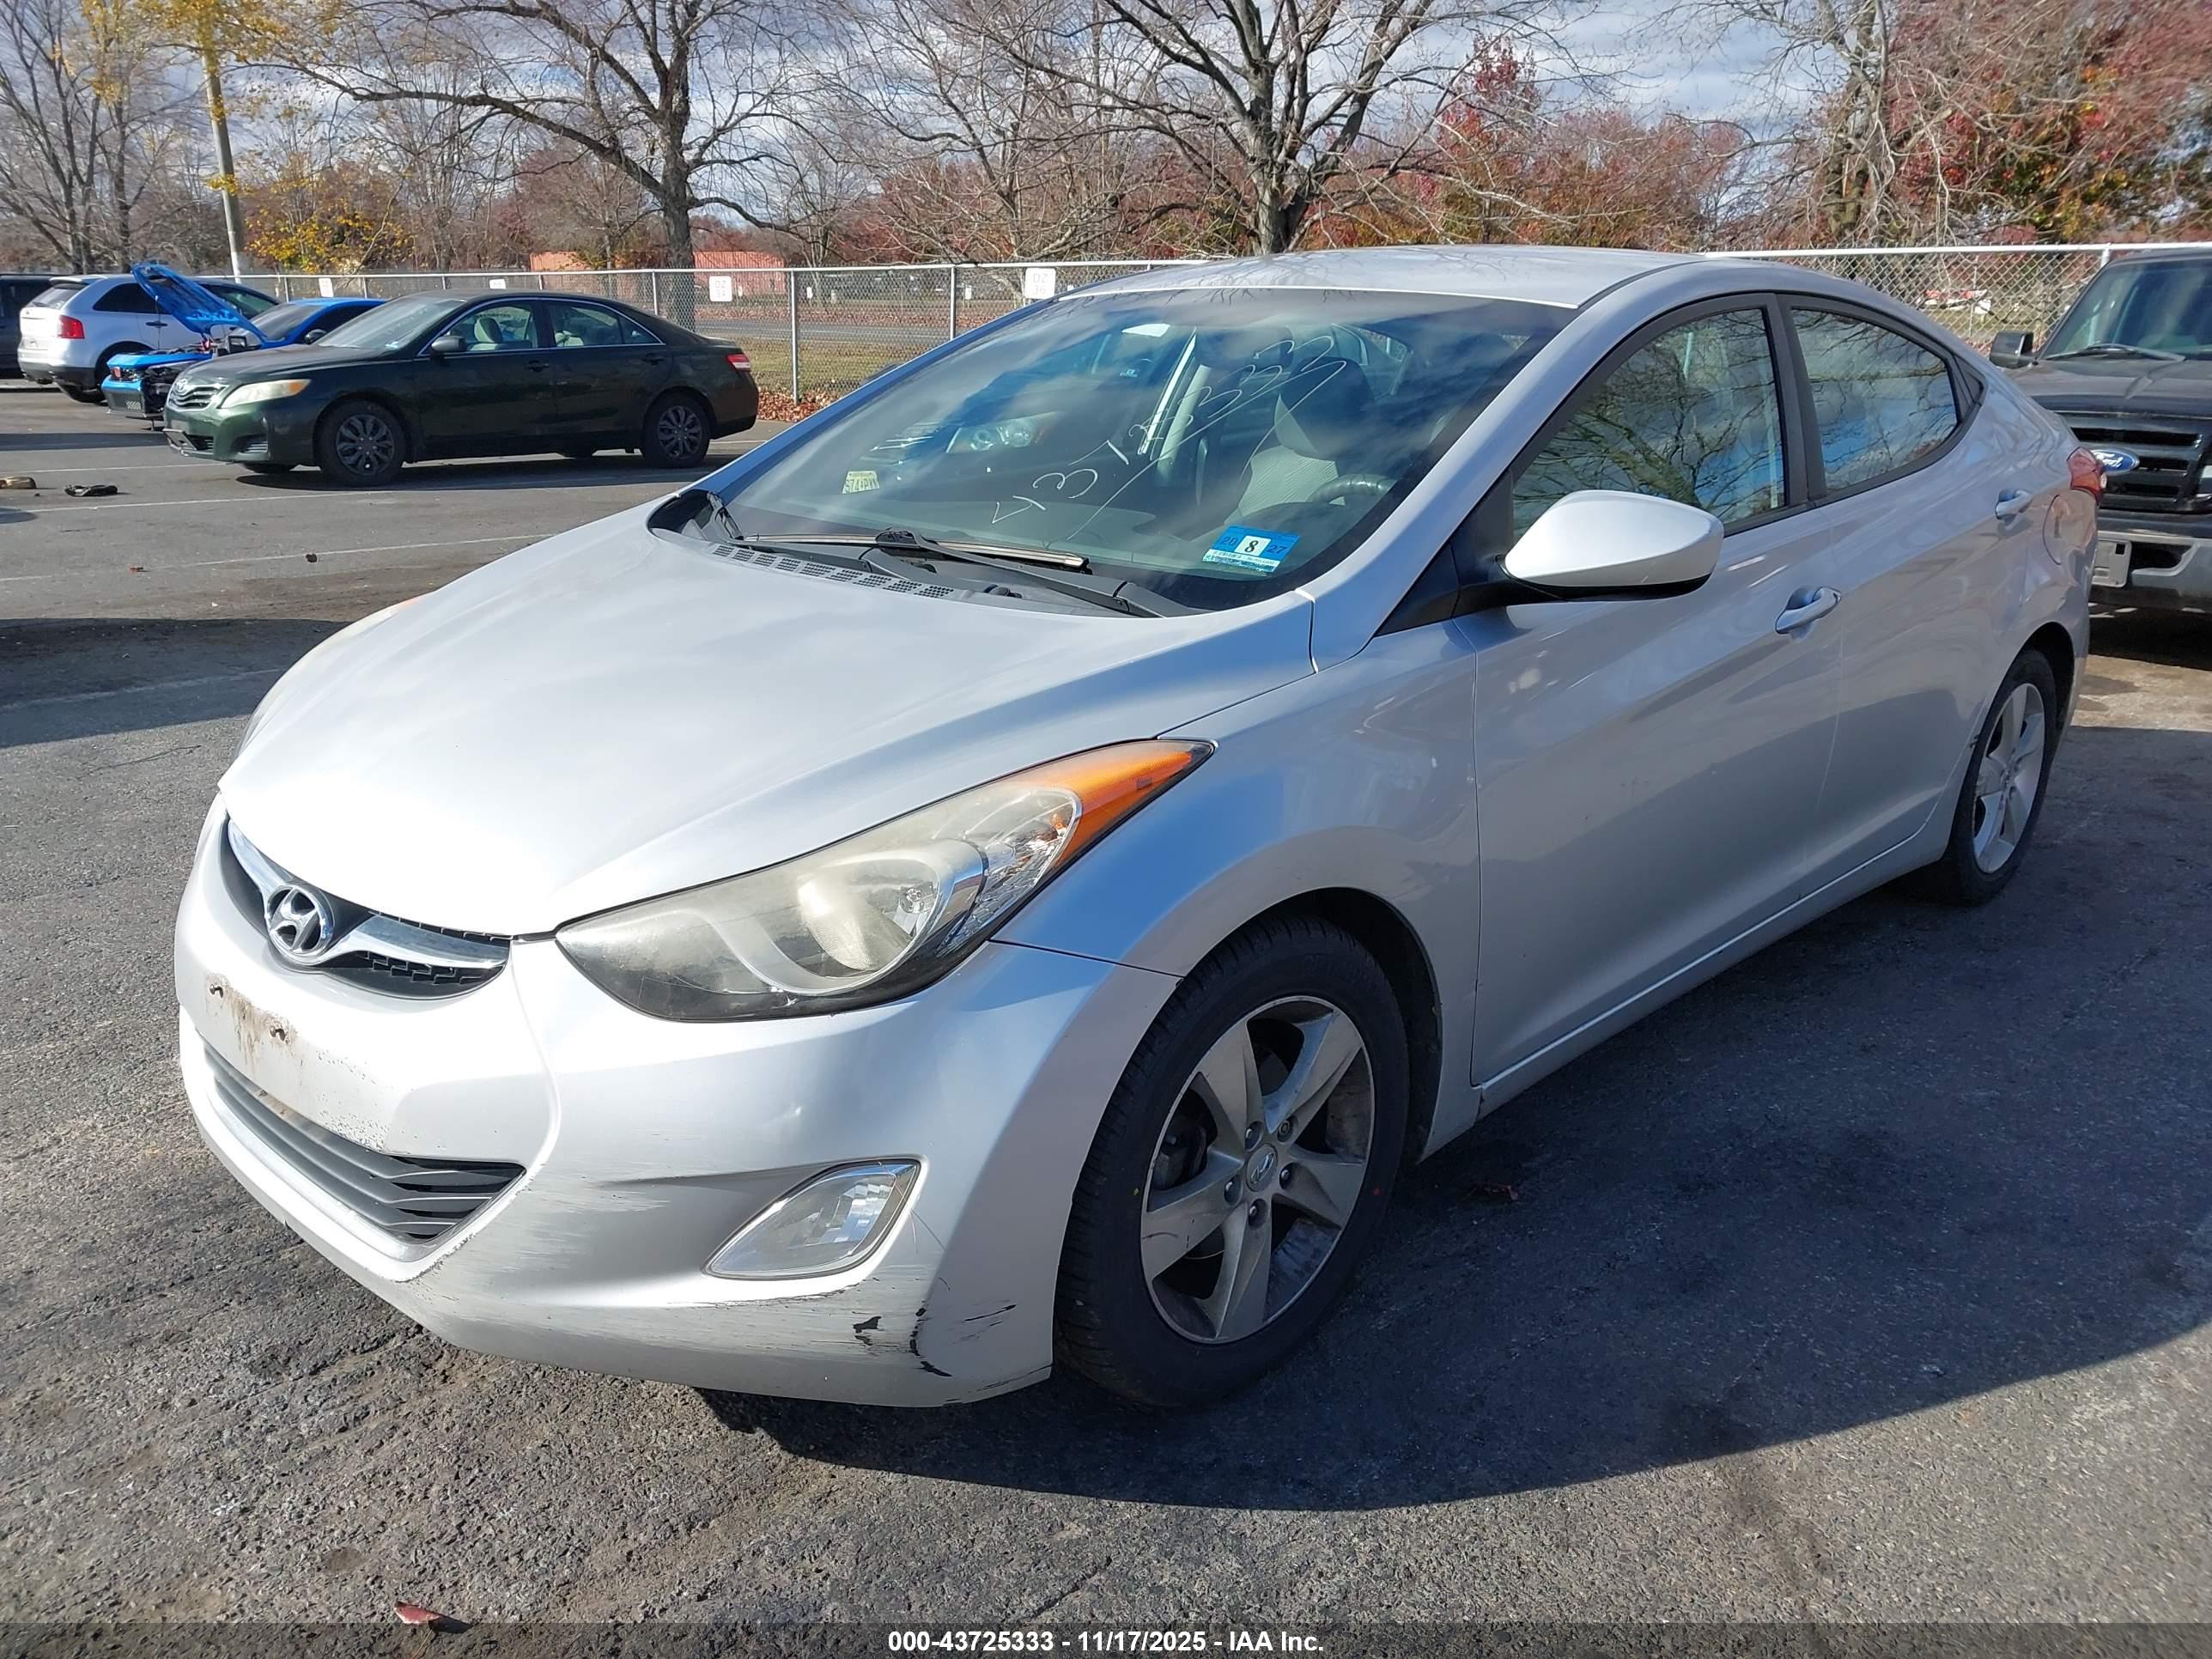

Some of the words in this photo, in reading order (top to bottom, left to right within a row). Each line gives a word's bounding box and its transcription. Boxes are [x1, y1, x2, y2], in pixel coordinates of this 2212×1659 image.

[1222, 536, 1238, 546] 20
[1244, 540, 1259, 553] 8
[1267, 544, 1286, 554] 27
